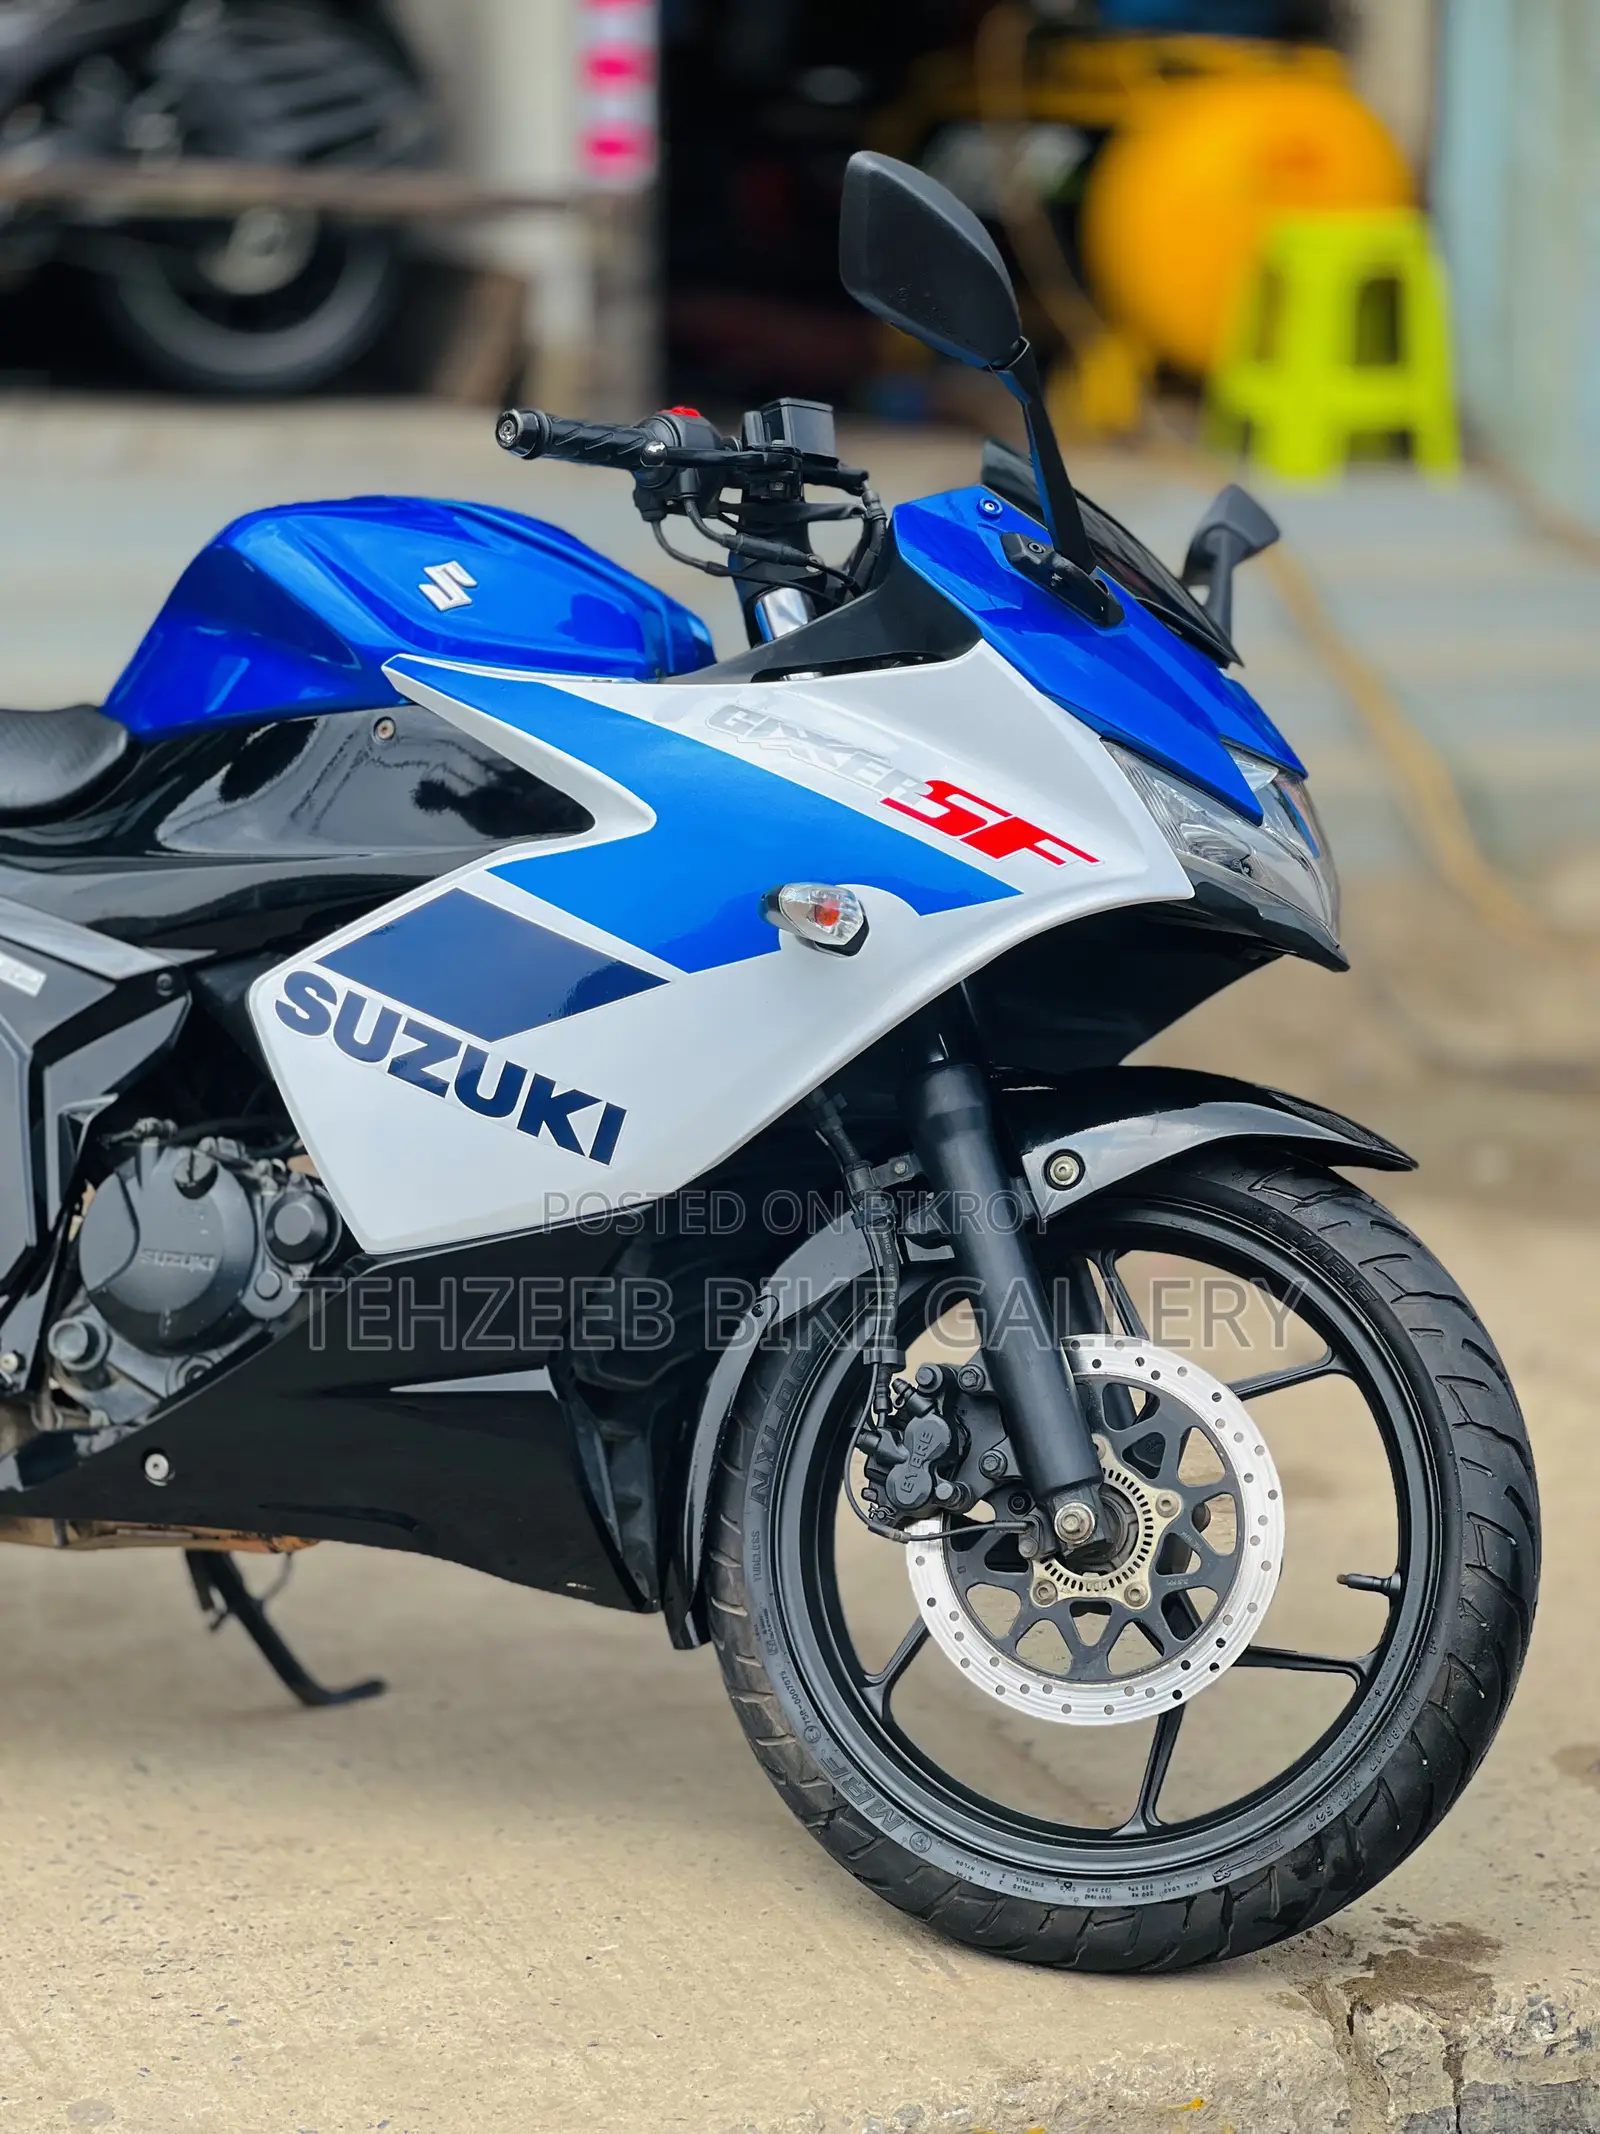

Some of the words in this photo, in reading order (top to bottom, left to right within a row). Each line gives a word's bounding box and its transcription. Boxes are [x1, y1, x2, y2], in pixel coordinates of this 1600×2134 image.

[881, 780, 1100, 866] SF
[275, 971, 627, 1167] SUZUKI
[138, 1248, 216, 1273] SUZUKI
[1292, 1228, 1378, 1302] MRF
[900, 1429, 934, 1494] BYBRE
[751, 1530, 761, 1582] TUBELESS
[1367, 1696, 1420, 1772] 100/80-17
[818, 1756, 906, 1831] MRF
